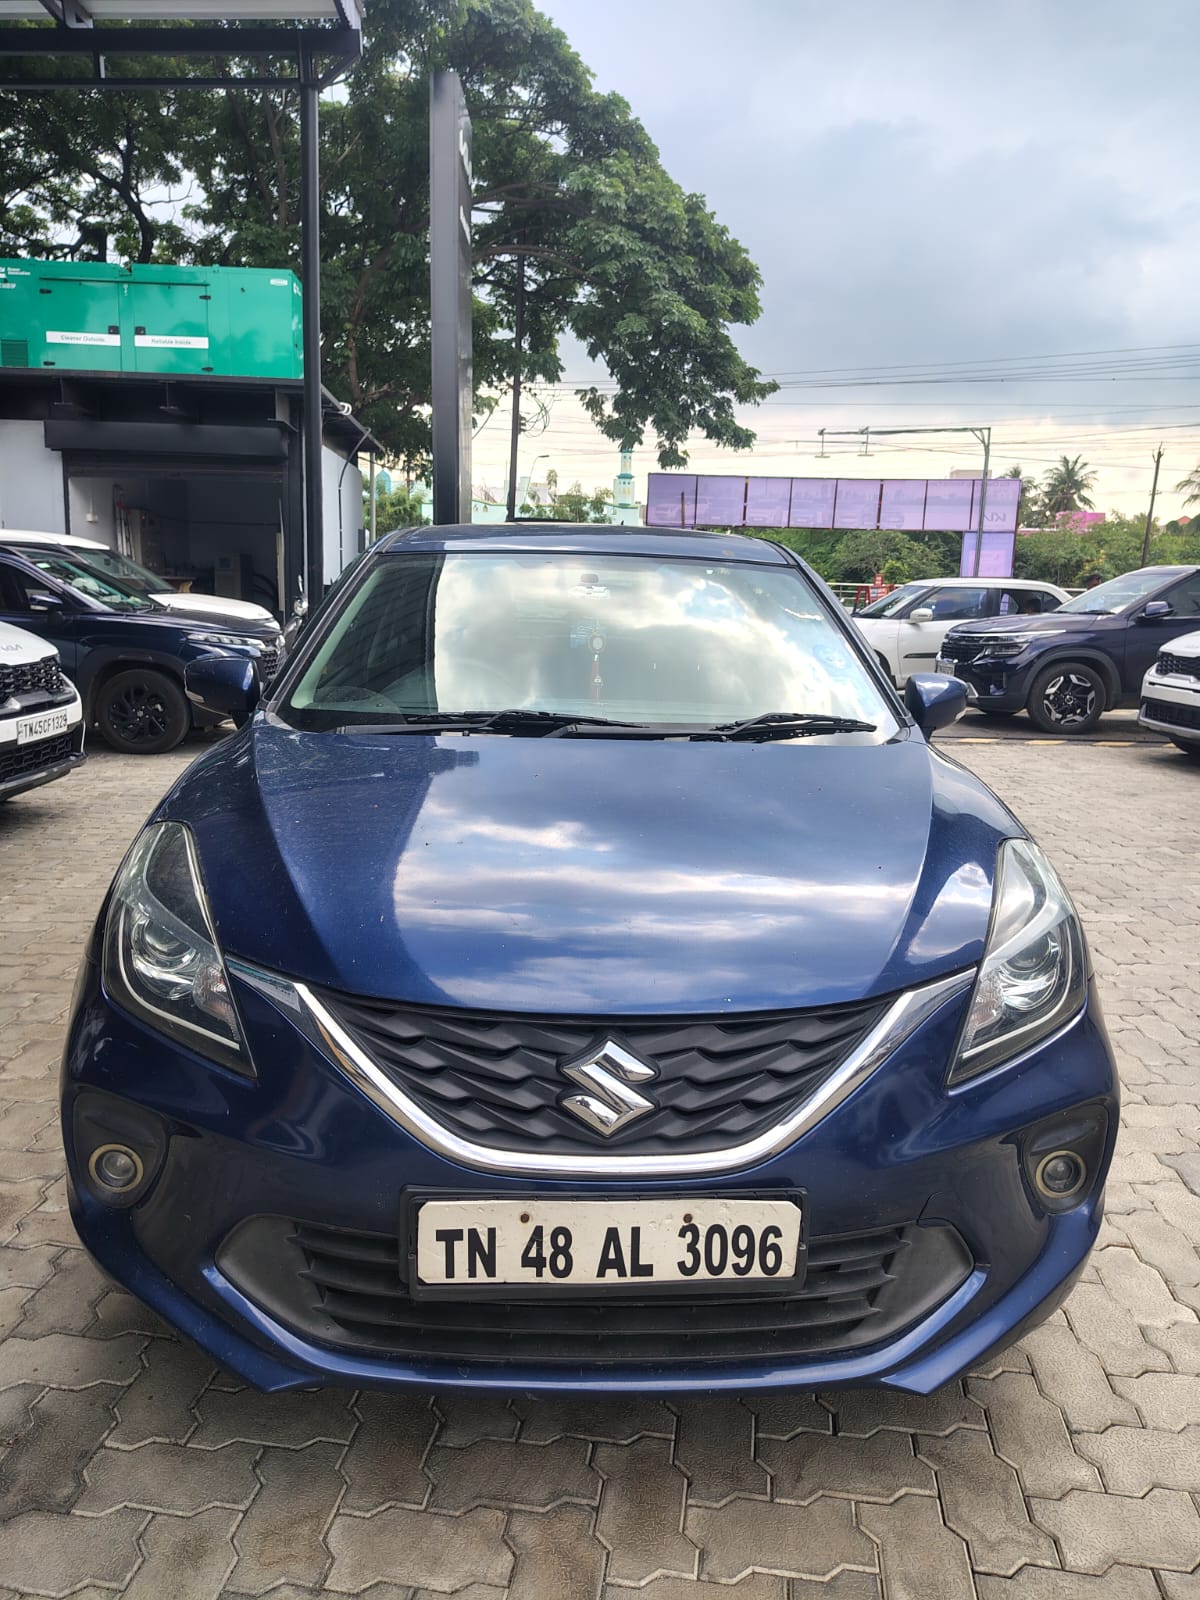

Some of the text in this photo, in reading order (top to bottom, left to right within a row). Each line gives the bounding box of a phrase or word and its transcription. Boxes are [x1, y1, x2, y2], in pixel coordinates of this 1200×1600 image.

[435, 1223, 783, 1279] TN 48 AL 3096
